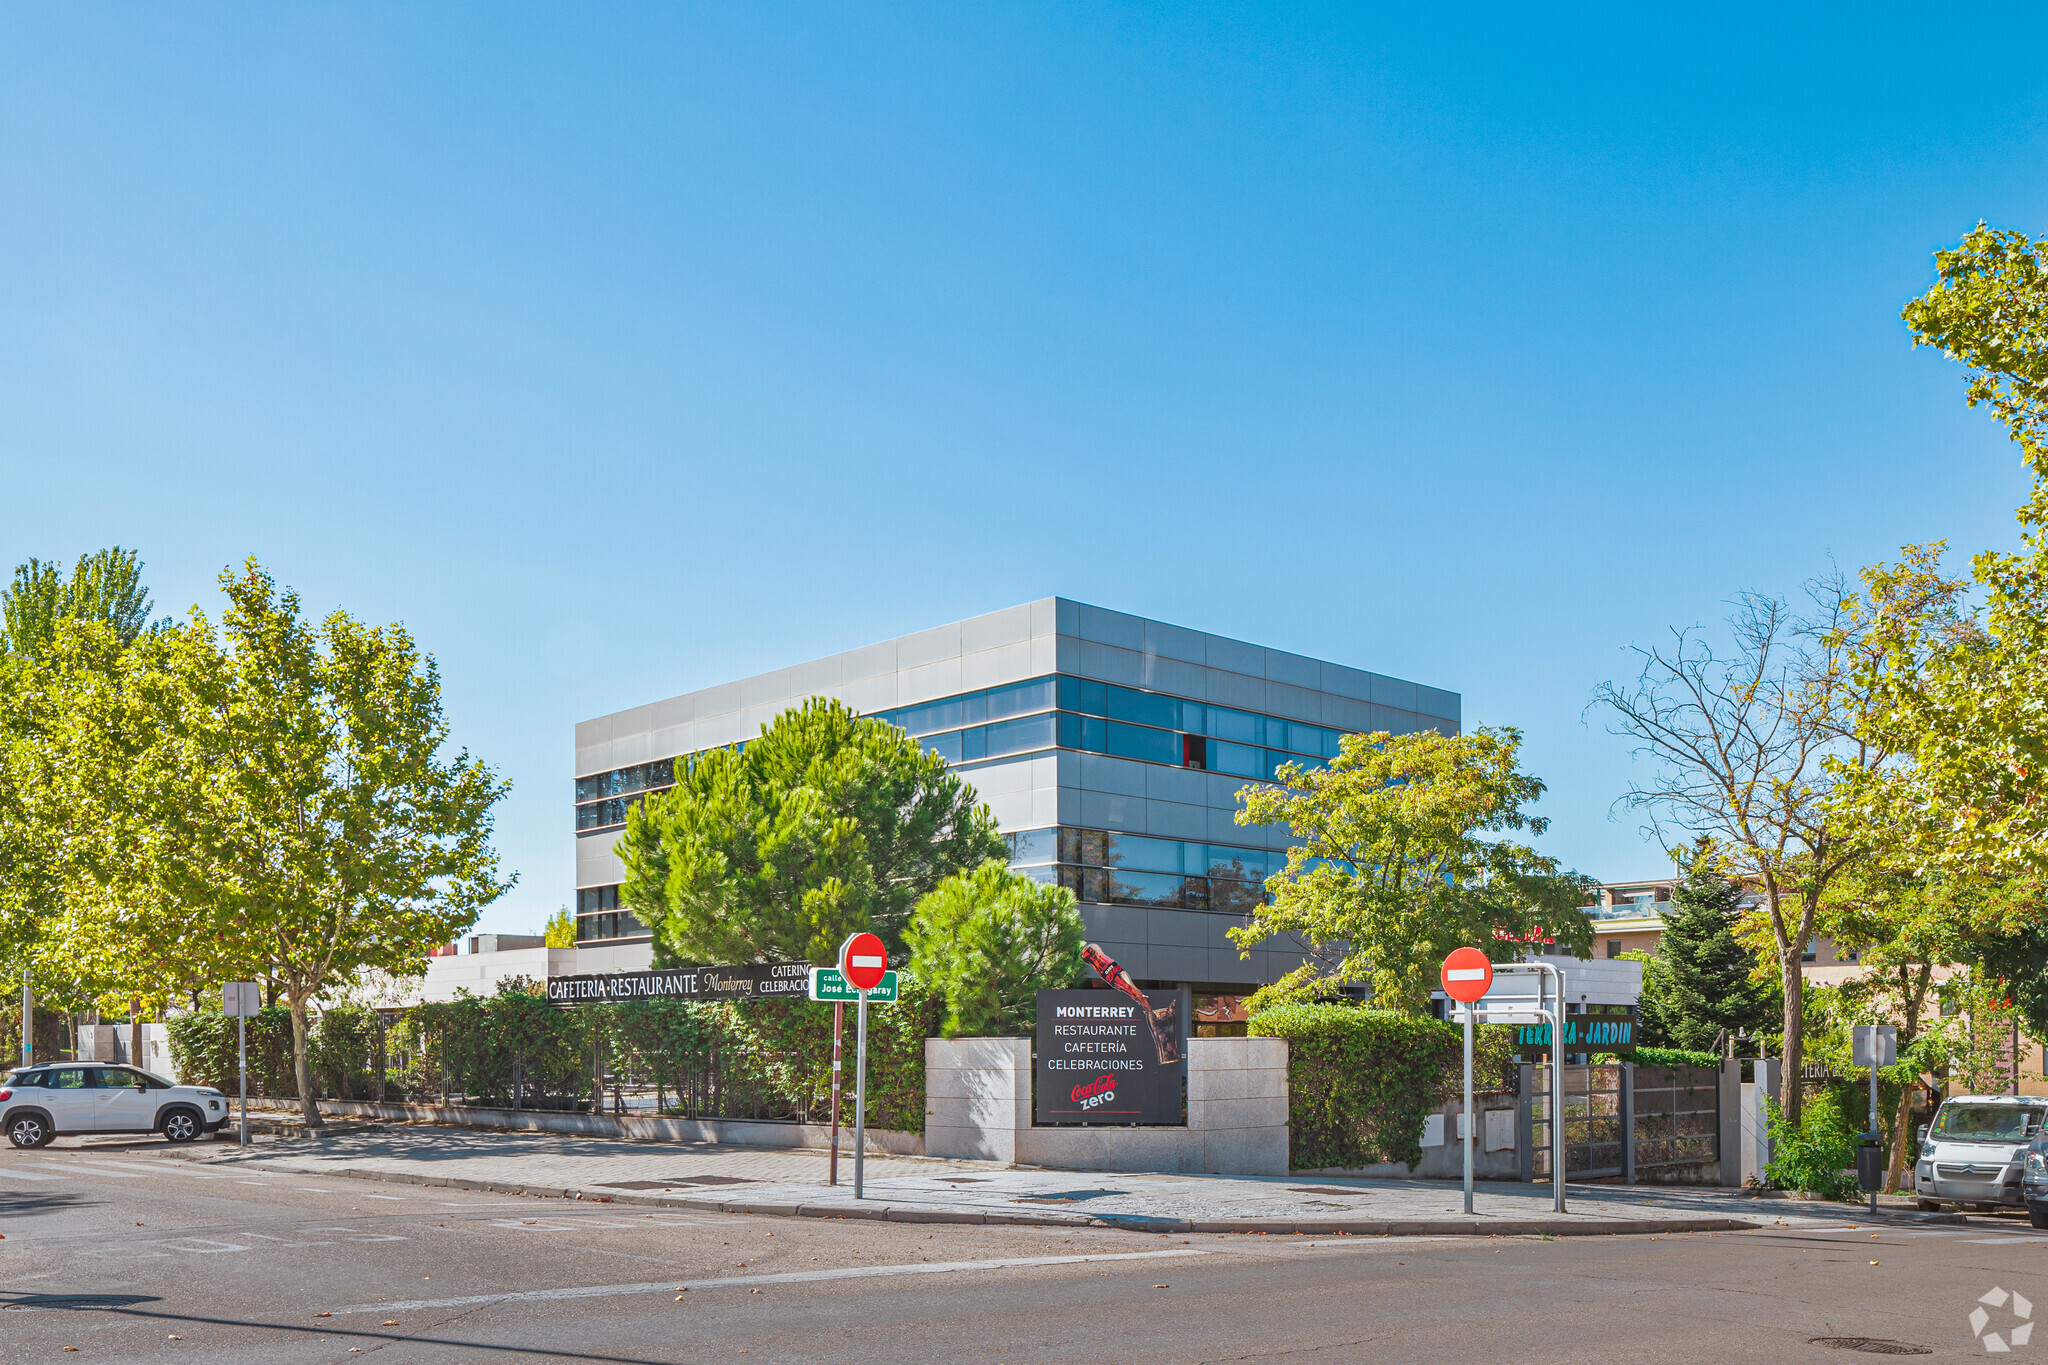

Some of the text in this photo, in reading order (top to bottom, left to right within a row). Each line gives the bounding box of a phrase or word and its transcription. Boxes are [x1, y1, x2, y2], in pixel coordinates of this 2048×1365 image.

[703, 973, 753, 995] Monterrey
[759, 979, 809, 993] CELEBRACIO
[821, 984, 843, 993] José
[1056, 1006, 1135, 1018] MONTERREY
[1054, 1025, 1137, 1036] RESTAURANTE
[1586, 1022, 1631, 1045] JARDIN
[1064, 1040, 1127, 1053] CAFETERÍA
[1048, 1059, 1143, 1071] CELEBRACIONES
[1071, 1072, 1116, 1102] Coca-Cola
[1080, 1091, 1115, 1110] zero
